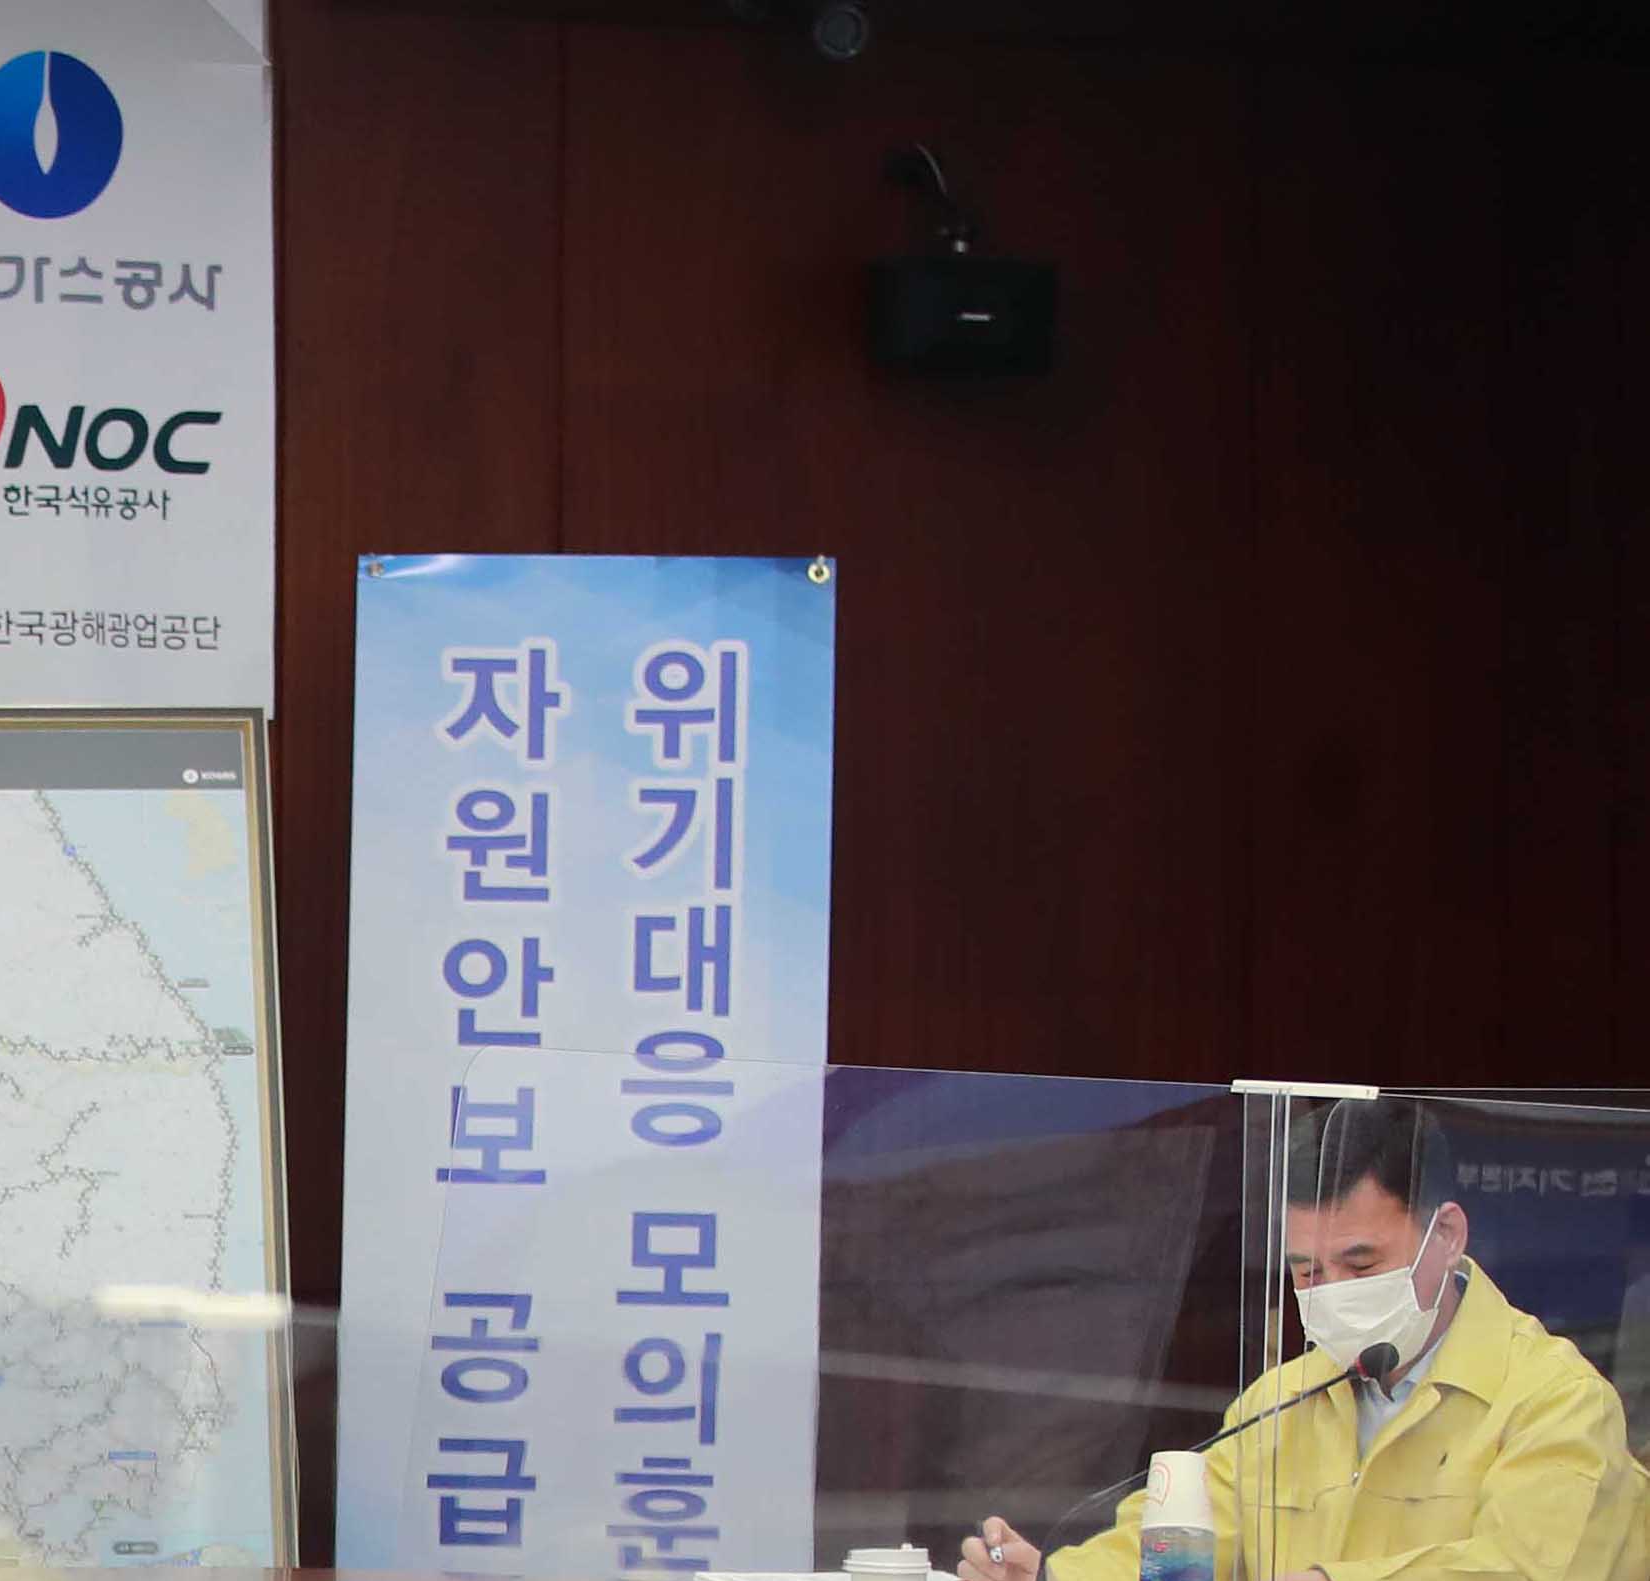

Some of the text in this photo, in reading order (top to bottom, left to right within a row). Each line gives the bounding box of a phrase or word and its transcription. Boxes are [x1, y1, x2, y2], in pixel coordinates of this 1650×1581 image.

[3, 484, 171, 521] 한국석유공사
[425, 647, 561, 1577] 자원안보 공급
[605, 641, 745, 1577] 위기대응 모의훈
